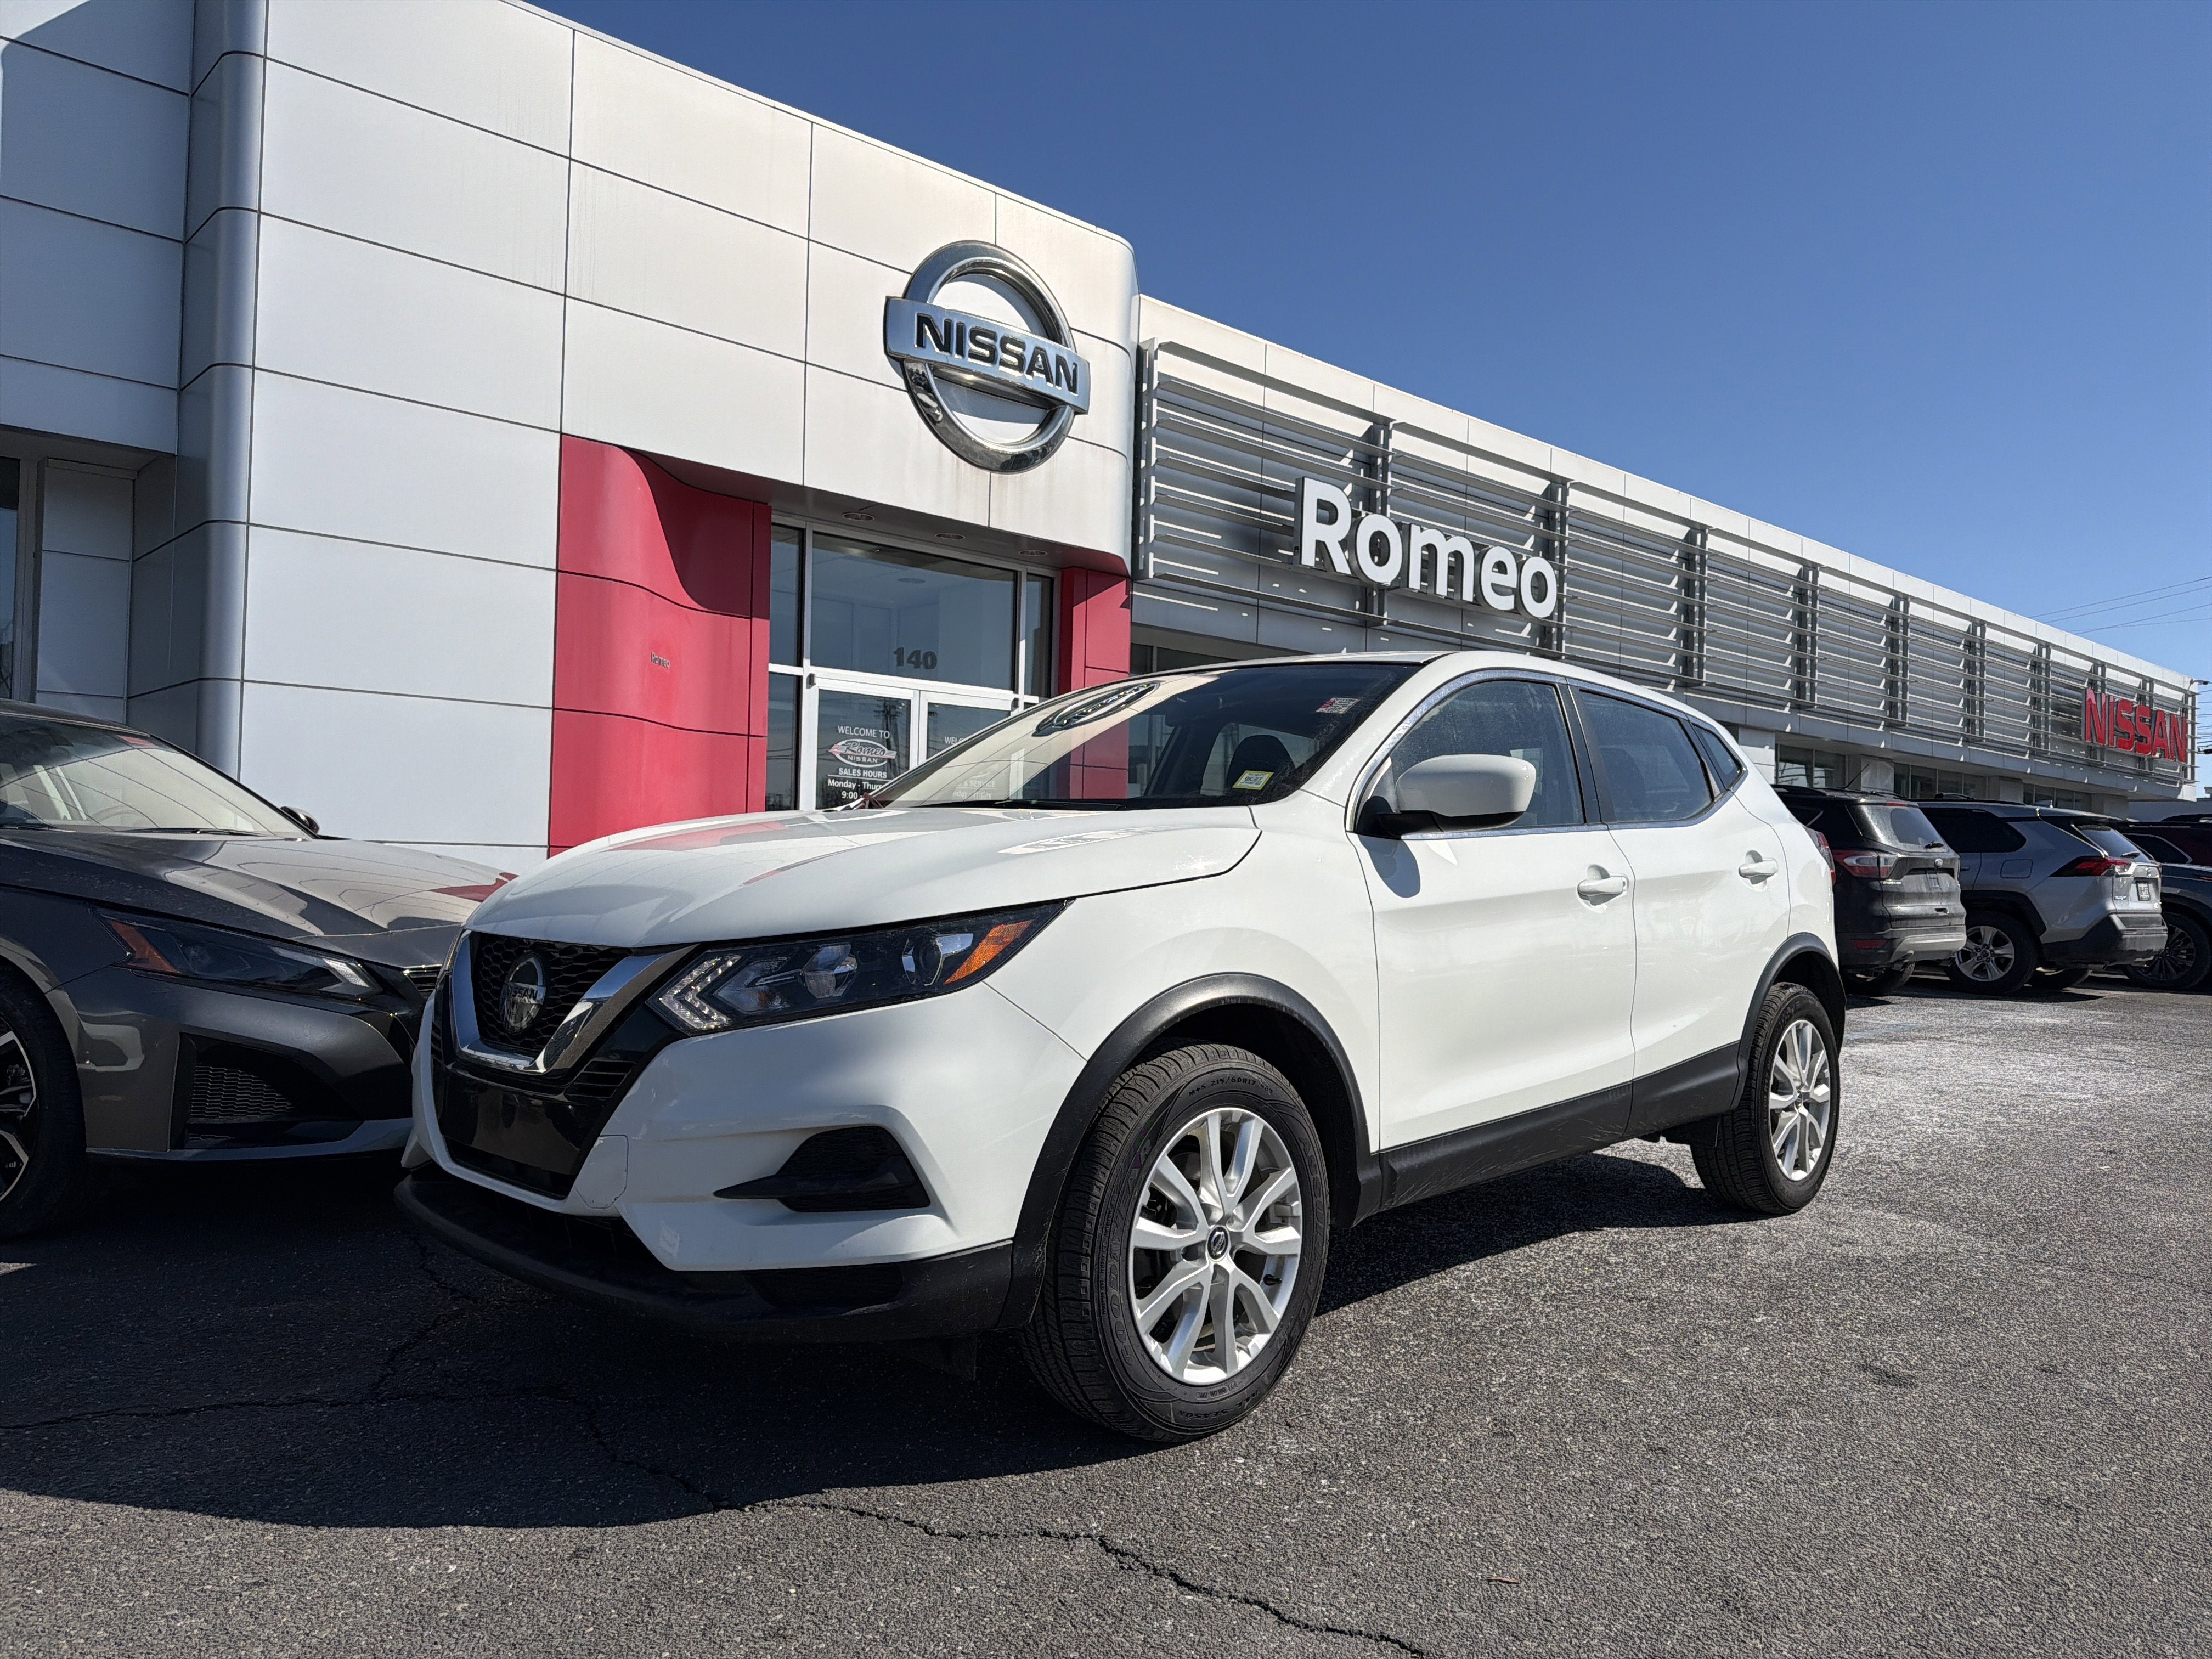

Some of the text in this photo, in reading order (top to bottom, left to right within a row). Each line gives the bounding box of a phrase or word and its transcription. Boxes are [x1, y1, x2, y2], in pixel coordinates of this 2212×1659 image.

[915, 312, 1080, 396] NISSAN
[1297, 476, 1558, 618] Romeo
[650, 651, 670, 669] Romeo
[893, 647, 938, 670] 140
[838, 725, 890, 739] WELCOME TO
[2084, 687, 2187, 763] NISSAN
[841, 740, 886, 756] Romeo
[945, 736, 964, 744] WELC
[838, 768, 887, 778] SALES HOURS
[828, 778, 856, 790] Monday
[862, 781, 882, 791] Thurs
[842, 791, 858, 799] 9:00
[952, 790, 967, 799] nday
[1189, 1084, 1206, 1097] M+S
[1210, 1076, 1256, 1086] 215/60R17
[1108, 1136, 1152, 1367] GOODYEAR
